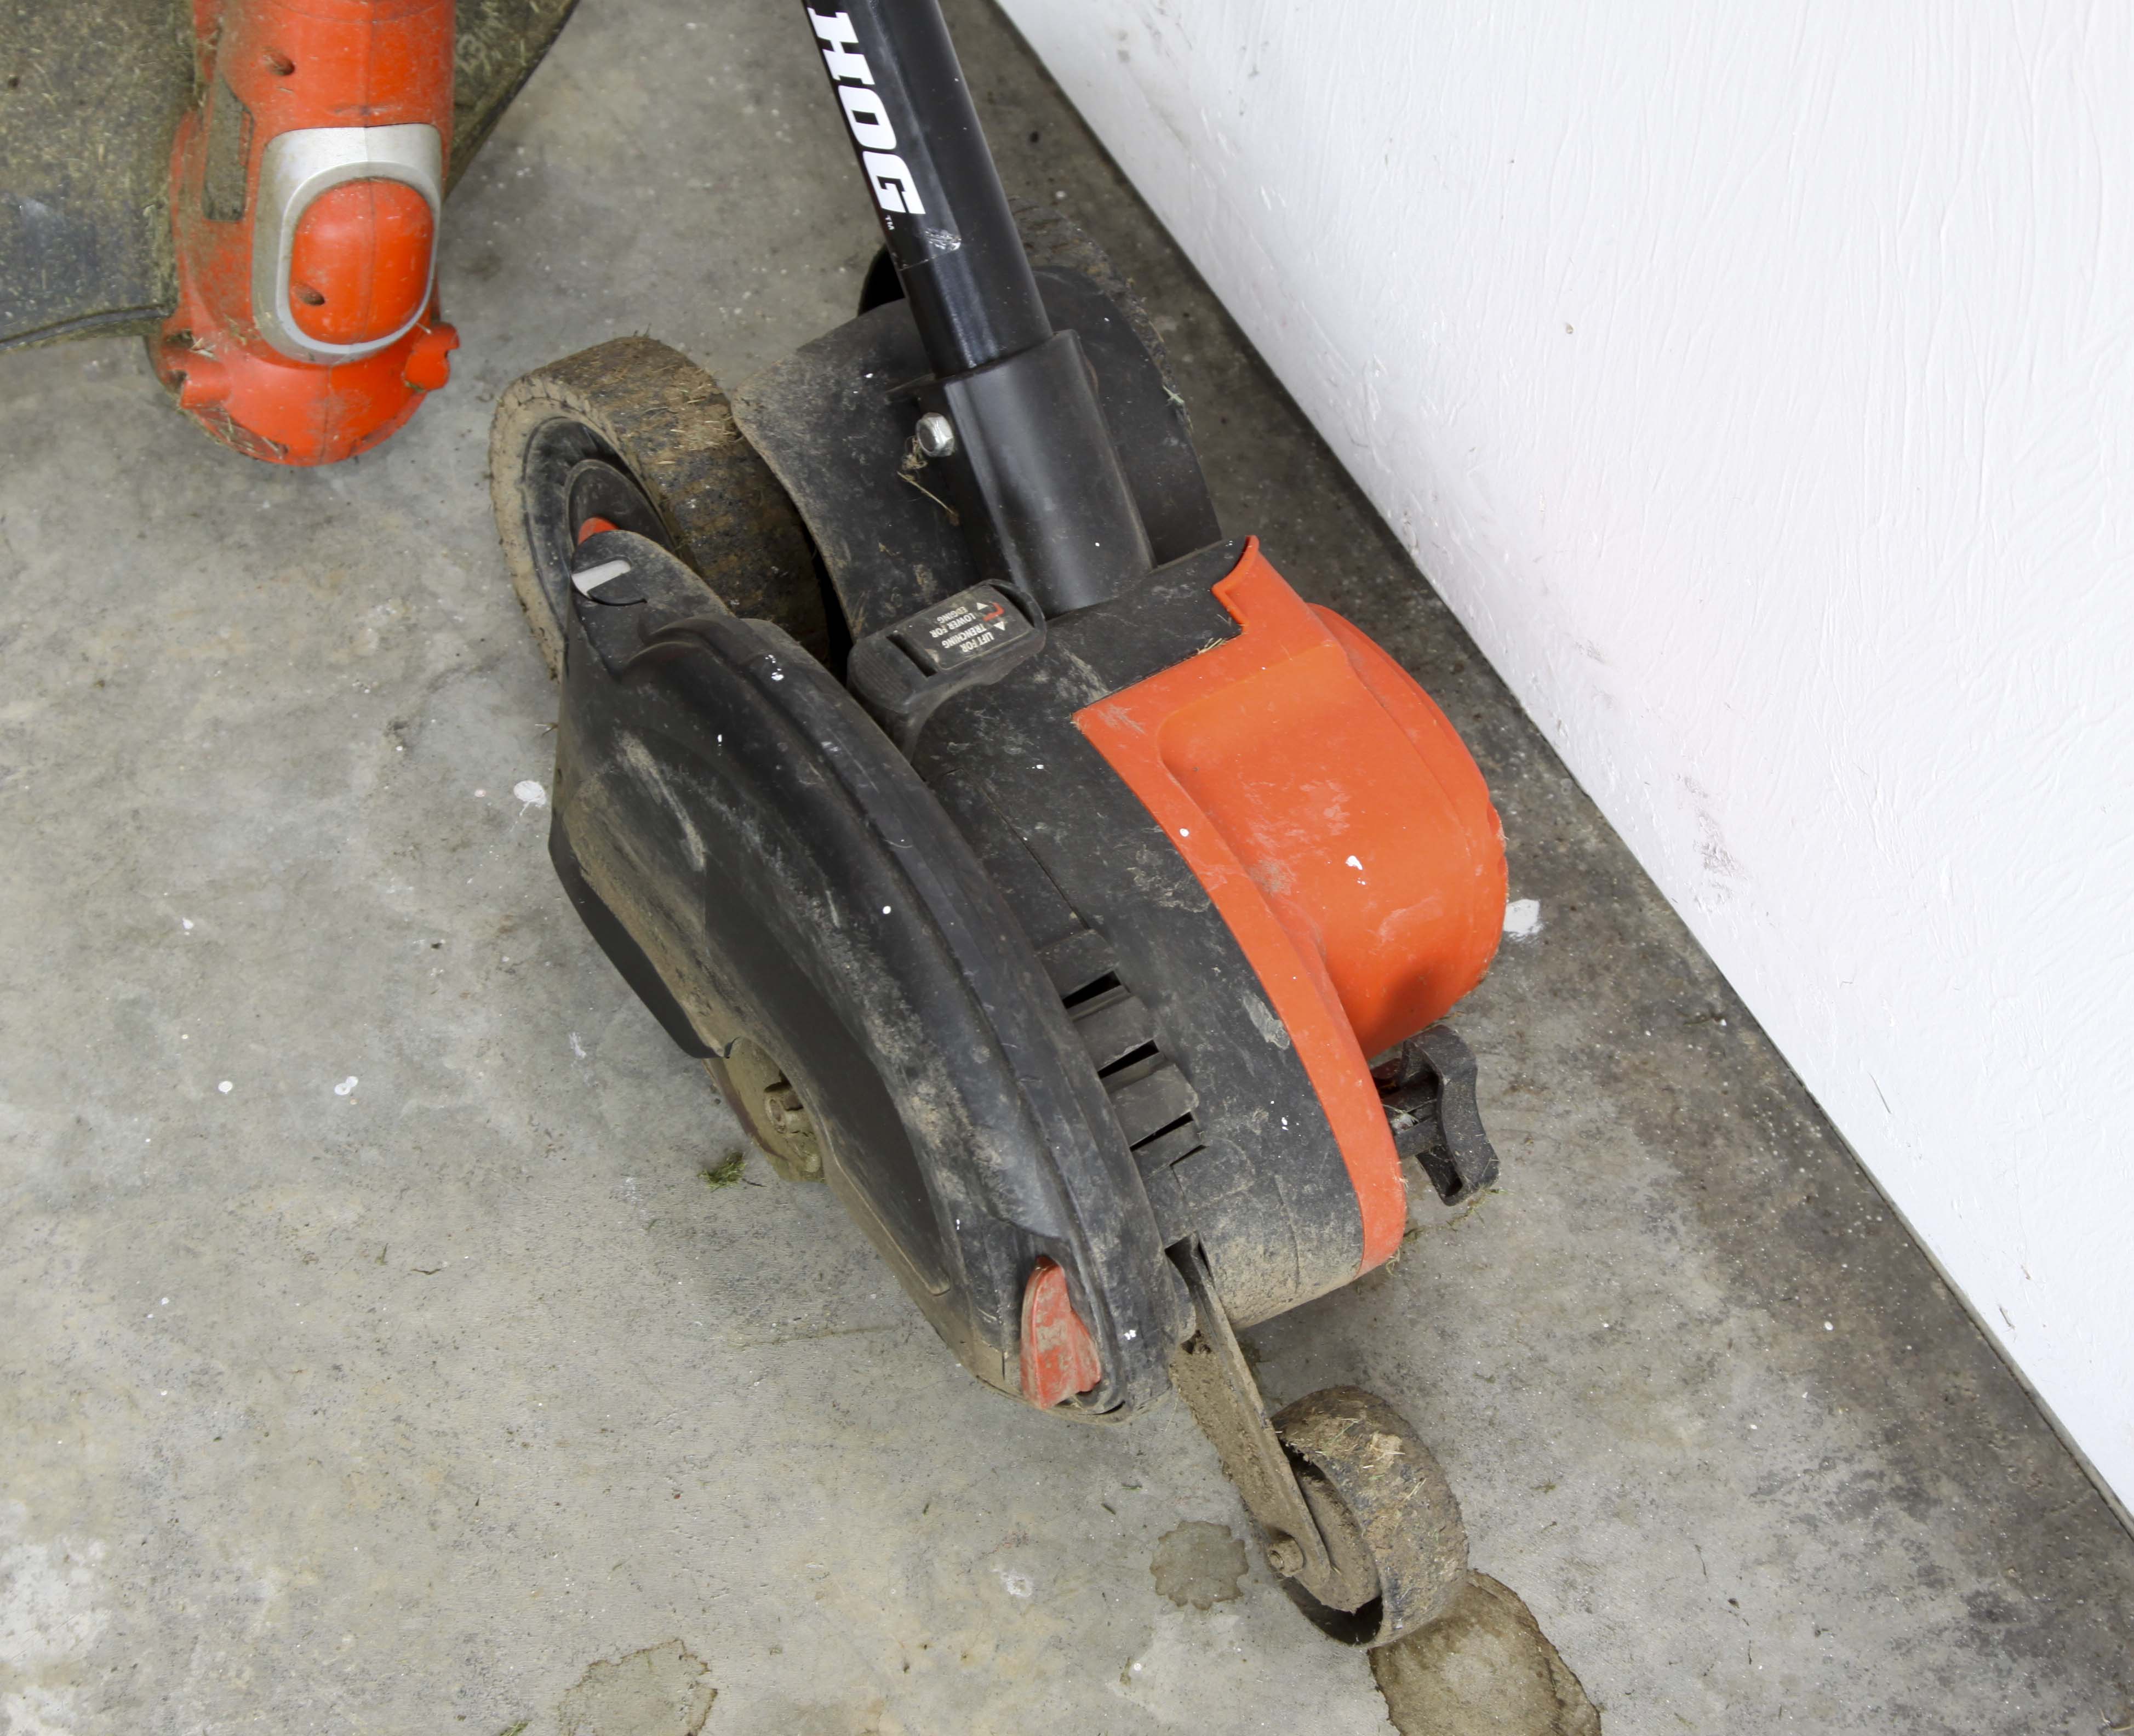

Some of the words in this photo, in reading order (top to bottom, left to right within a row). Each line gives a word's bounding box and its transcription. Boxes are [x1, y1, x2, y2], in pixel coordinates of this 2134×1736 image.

[807, 7, 925, 214] HOG
[937, 607, 968, 623] EDGING
[948, 613, 976, 630] LOWER
[930, 625, 948, 638] FOR
[942, 624, 987, 648] TRENCHING
[978, 632, 994, 646] LIFT
[960, 639, 978, 652] FOR
